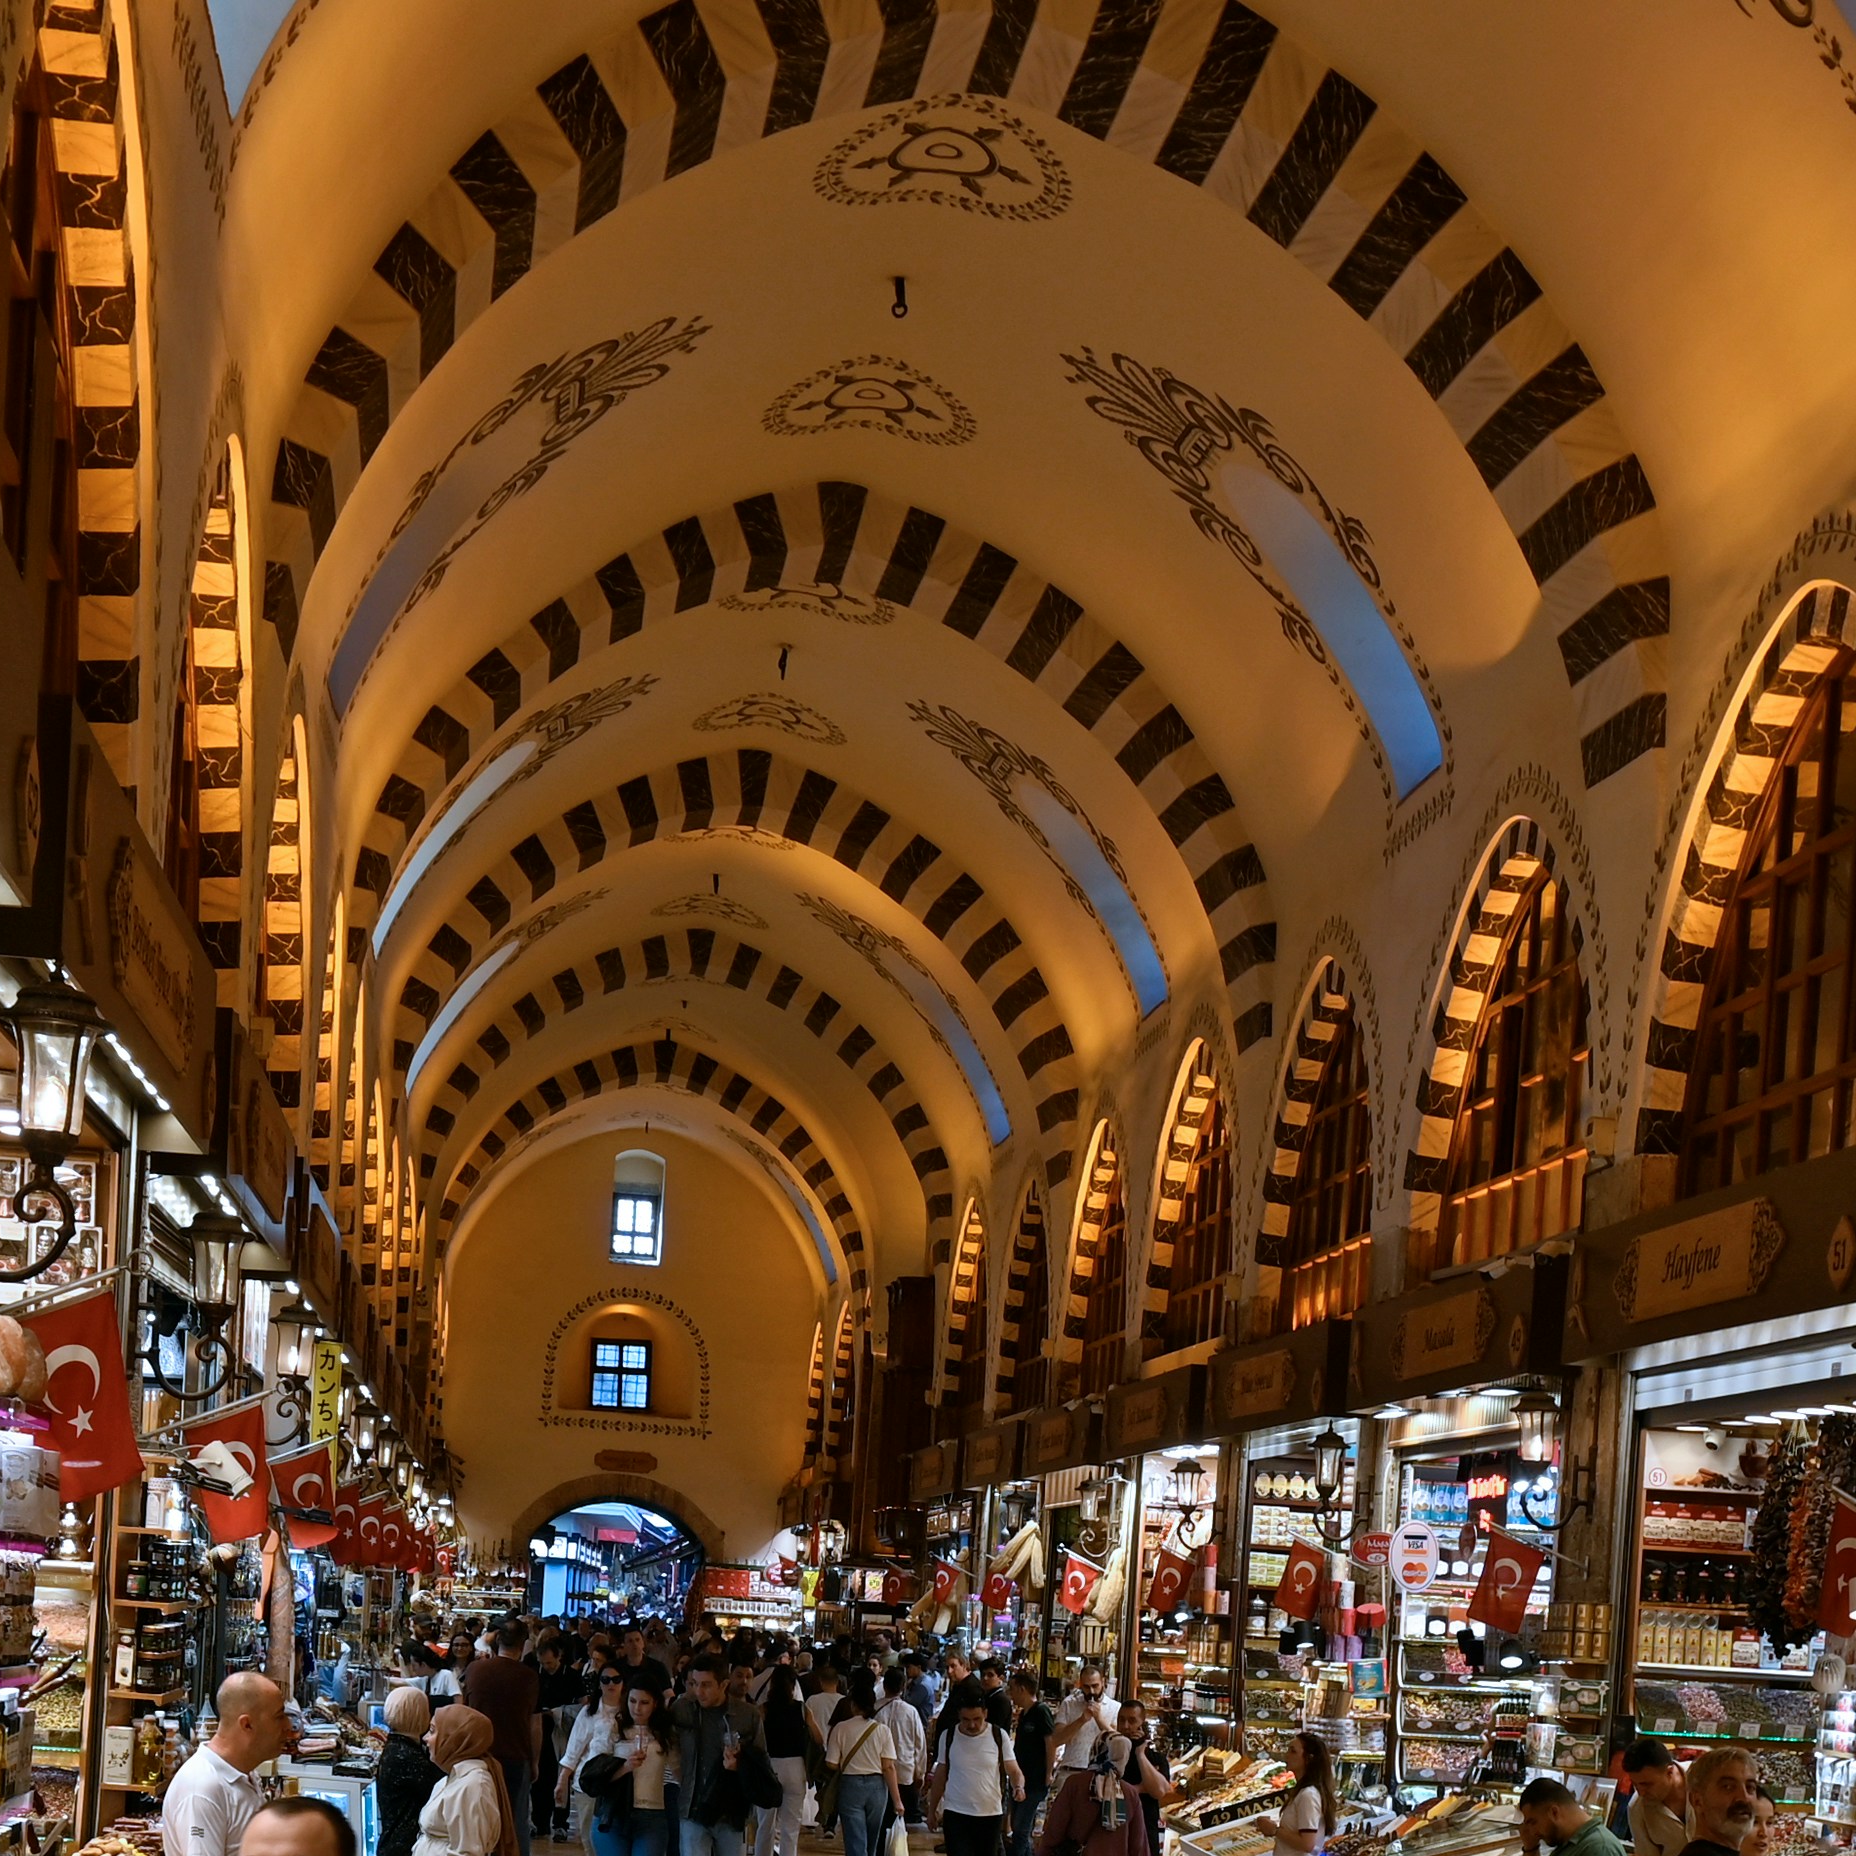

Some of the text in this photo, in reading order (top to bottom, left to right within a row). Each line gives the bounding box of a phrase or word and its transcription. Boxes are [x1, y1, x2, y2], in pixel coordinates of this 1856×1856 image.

[1661, 1236, 1722, 1291] Hayfene
[1831, 1237, 1847, 1272] 51
[1510, 1327, 1522, 1351] 49
[1652, 1472, 1664, 1483] 51
[1407, 1540, 1424, 1550] VISA
[1211, 1793, 1290, 1827] 49 MASA
